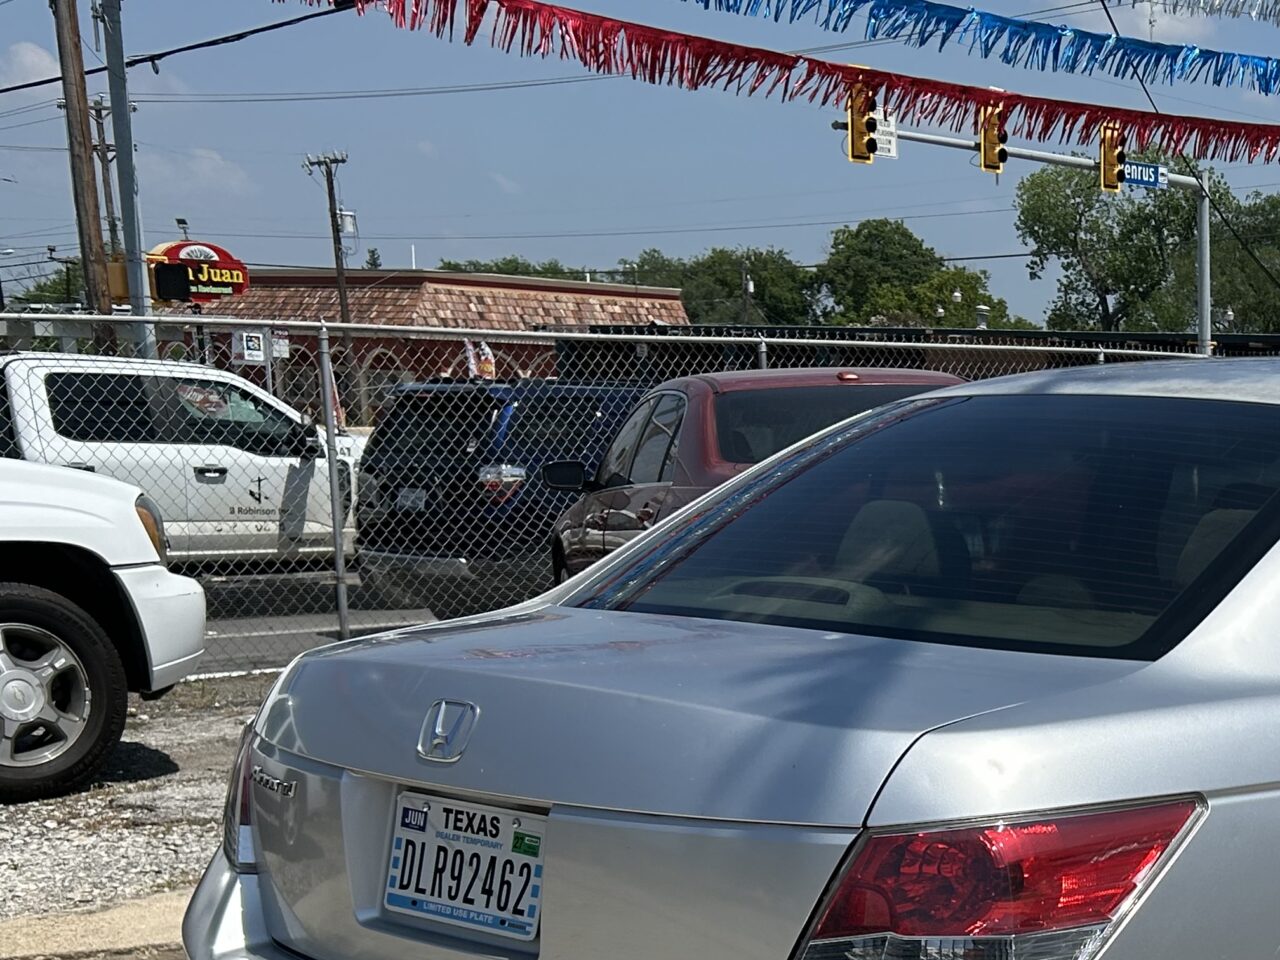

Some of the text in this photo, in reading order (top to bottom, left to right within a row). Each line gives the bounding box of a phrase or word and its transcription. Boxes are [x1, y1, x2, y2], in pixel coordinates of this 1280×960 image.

[1124, 164, 1155, 182] enrus
[198, 264, 244, 283] Juan
[404, 810, 425, 827] JUN
[443, 807, 500, 839] TEXAS
[435, 831, 504, 850] DEALER TEMPORARY
[398, 838, 532, 916] DLR92462
[423, 901, 494, 925] LIMITED USE PLATE
